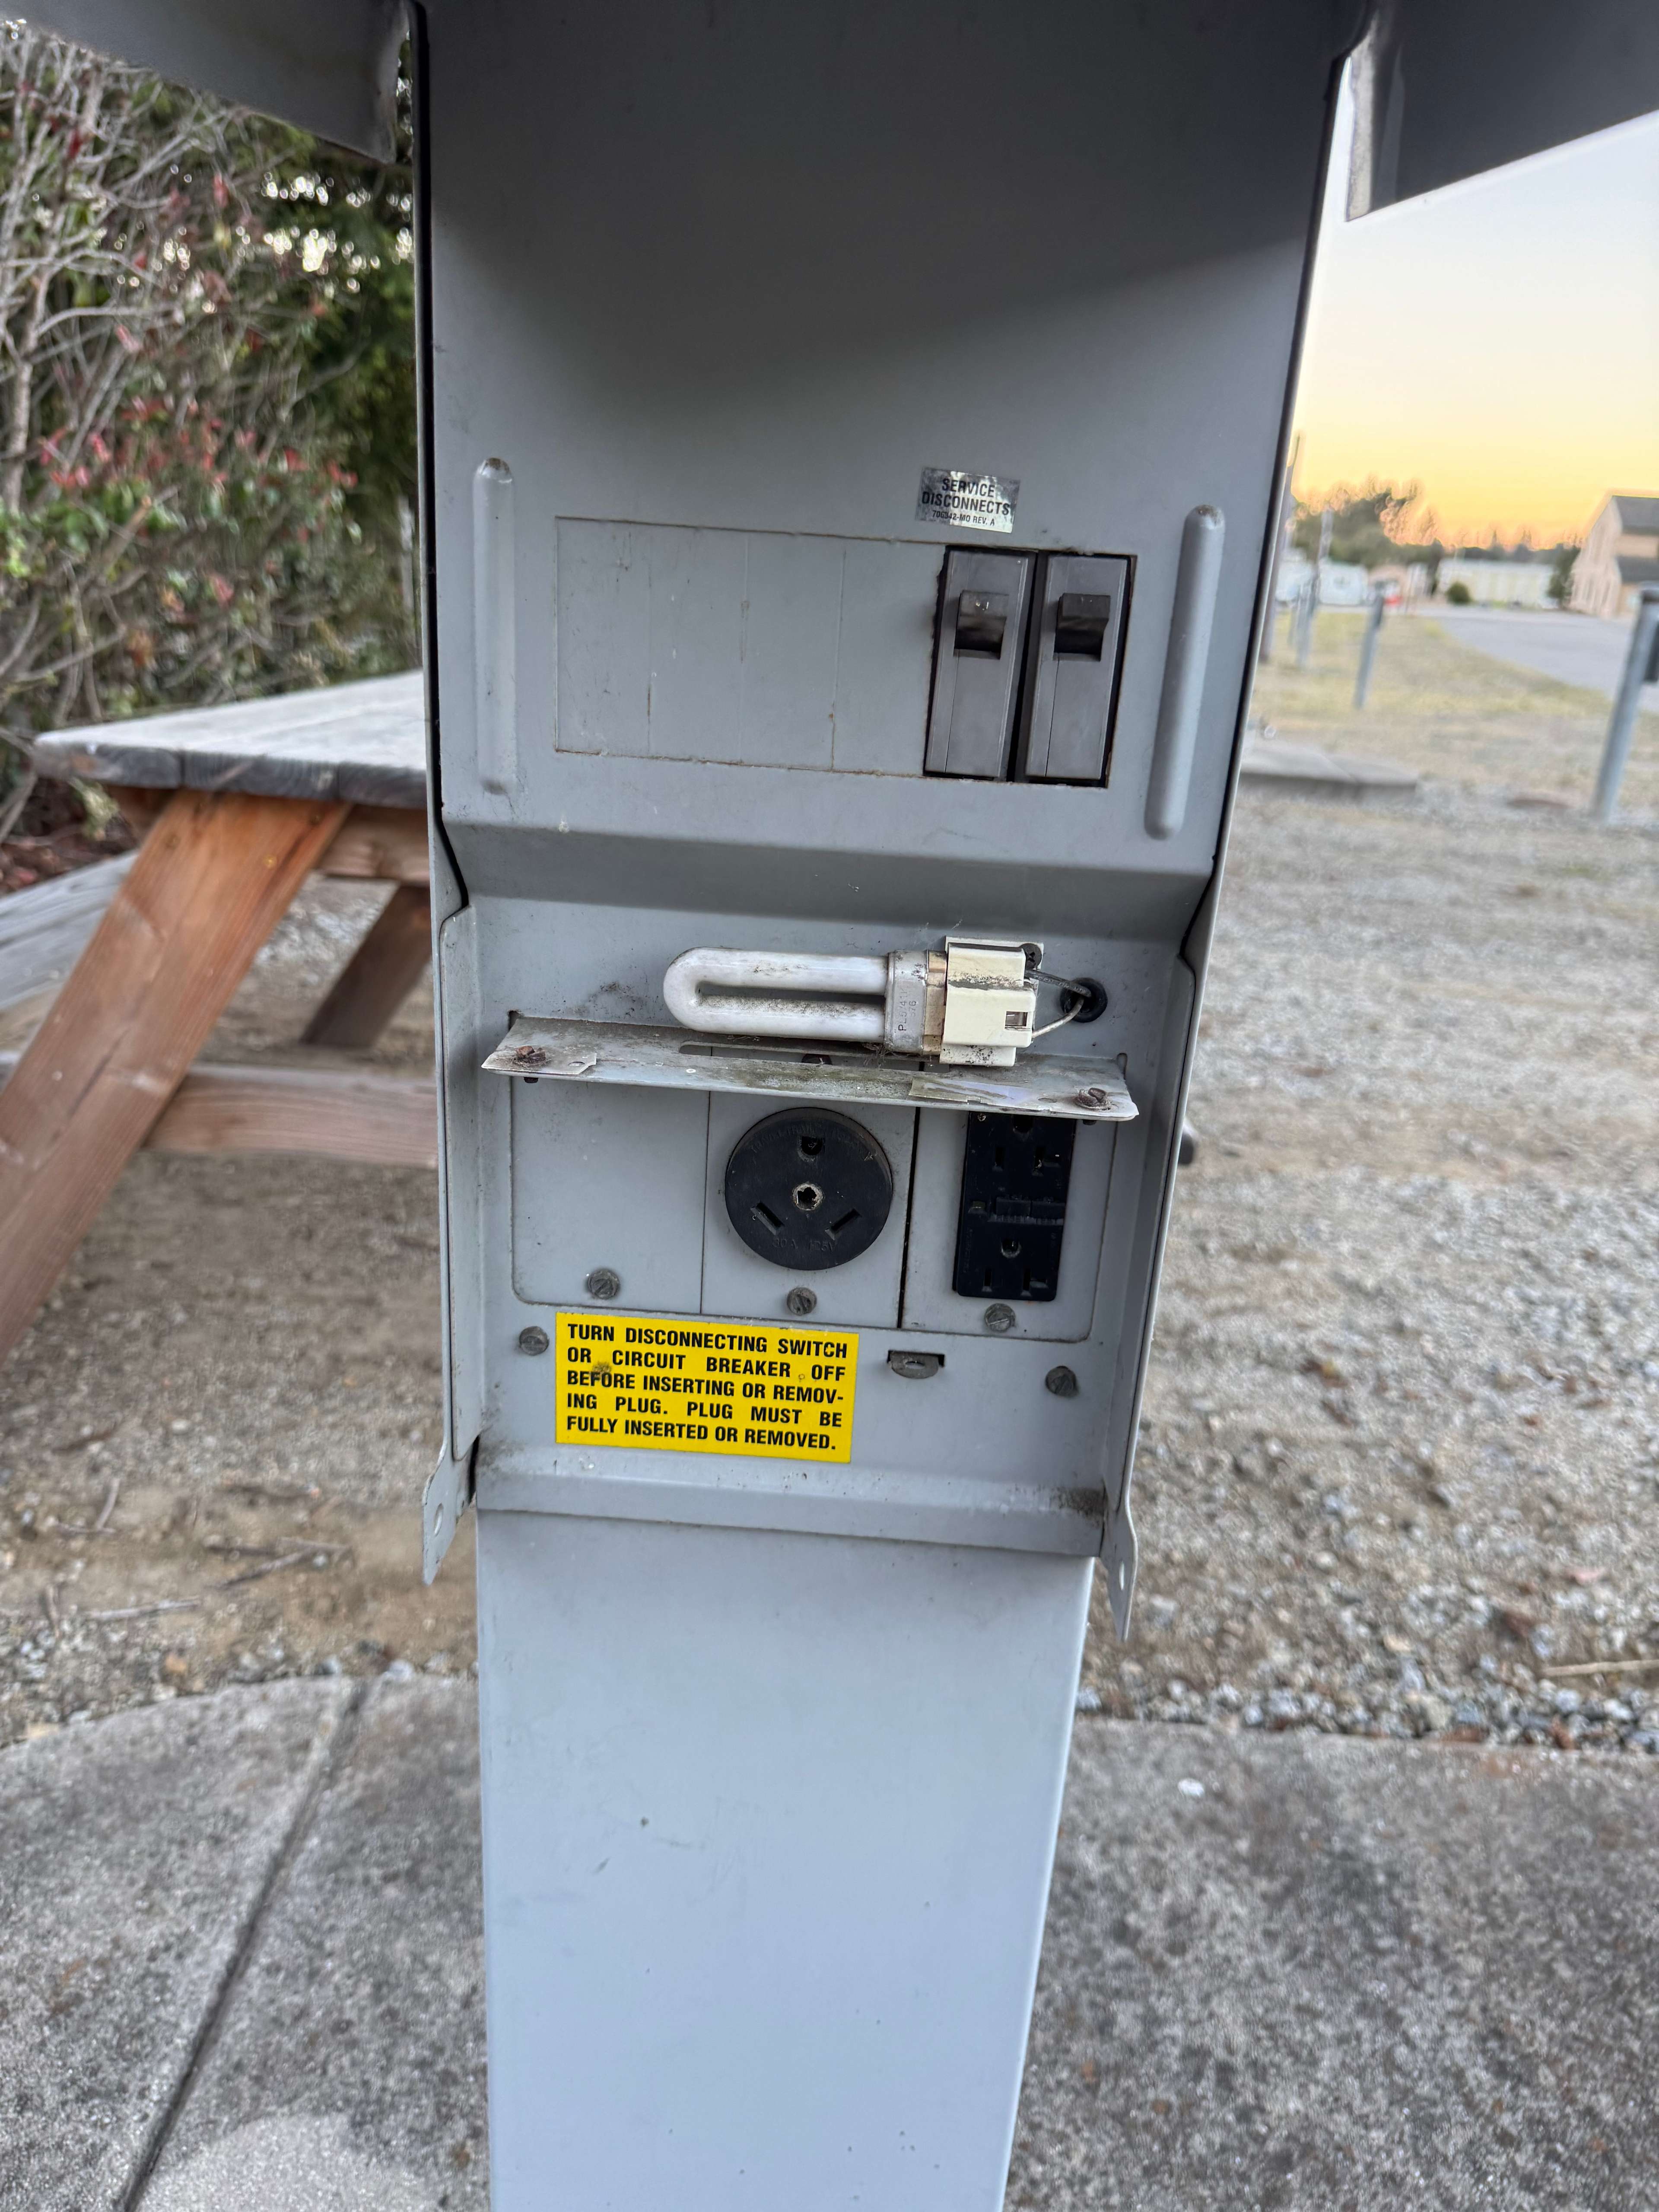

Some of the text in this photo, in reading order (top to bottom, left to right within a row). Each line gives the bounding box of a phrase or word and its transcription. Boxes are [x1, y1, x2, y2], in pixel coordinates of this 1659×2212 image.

[922, 491, 1010, 515] DISCONNECTS
[942, 477, 995, 498] SERVICE
[973, 516, 988, 525] REV.
[568, 1323, 847, 1358] TURN DISCONNECTING SWITCH
[568, 1347, 845, 1381] OR CIRCUIT BREAKER OFF
[567, 1370, 843, 1404] BEFORE INSERTING OR REMOV-
[567, 1393, 842, 1427] ING PLUG. PLUG MUST BE
[567, 1416, 836, 1450] FULLY INSERTED OR REMOVED.
